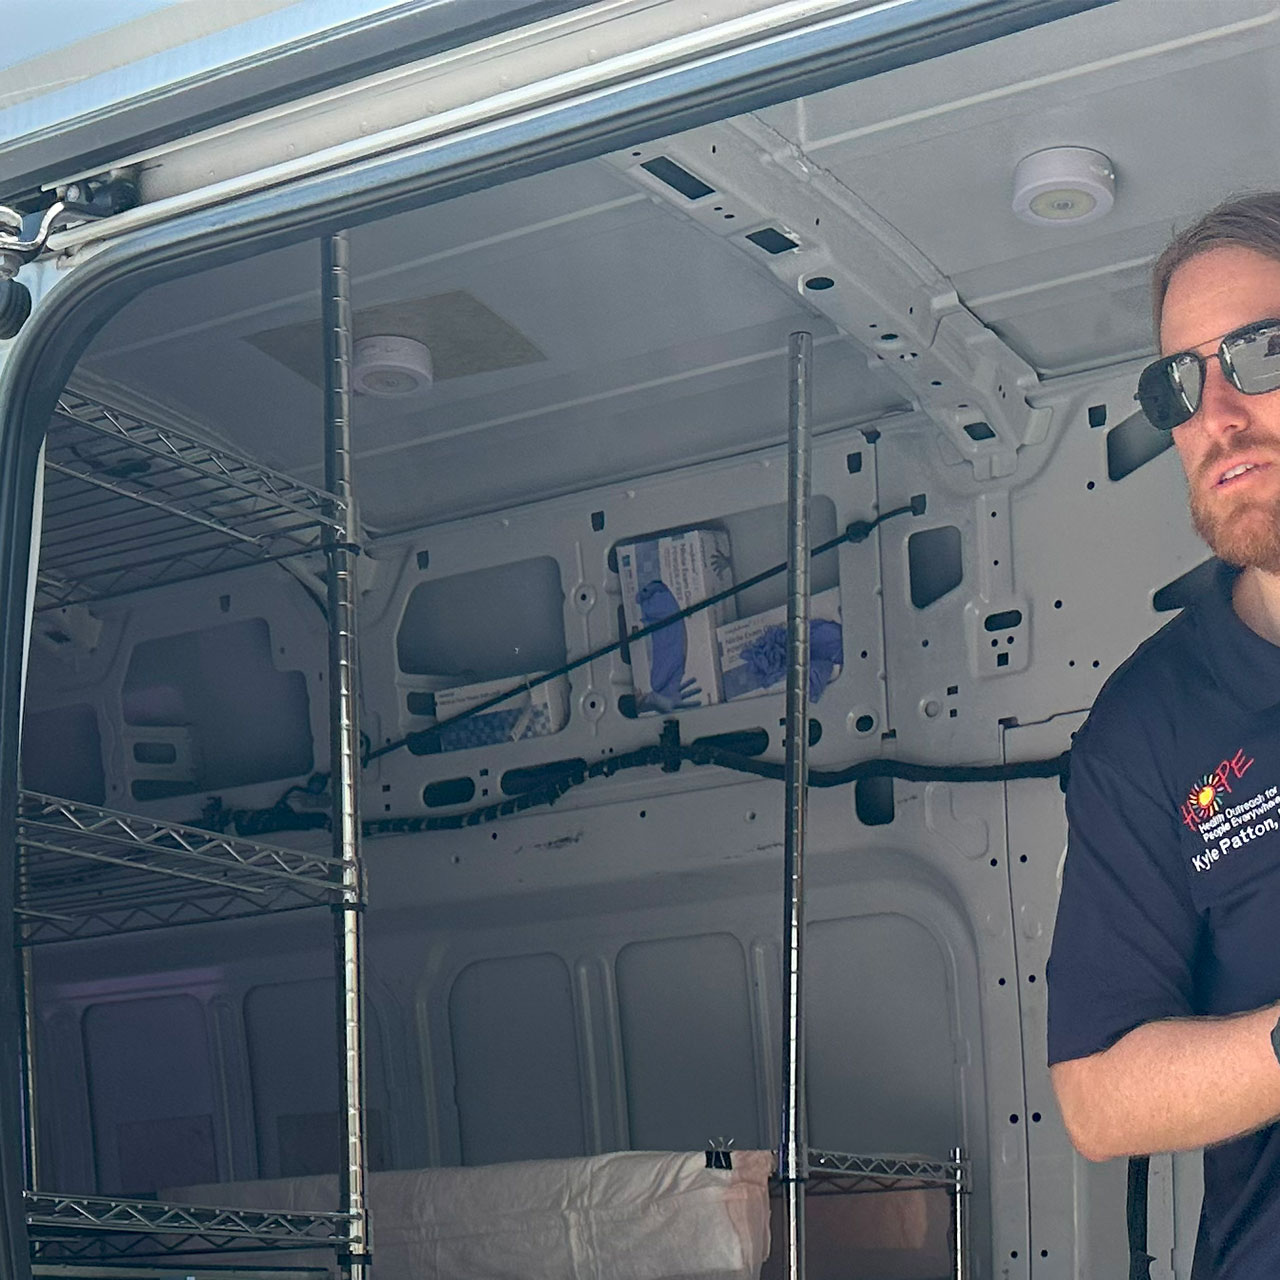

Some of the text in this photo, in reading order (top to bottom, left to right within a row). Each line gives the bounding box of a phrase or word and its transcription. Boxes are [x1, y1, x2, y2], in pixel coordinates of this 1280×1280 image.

[1180, 748, 1254, 832] HOPE
[1198, 785, 1279, 833] Health Outreach for
[1191, 846, 1221, 872] Kyle
[1219, 818, 1279, 855] Patton,
[1202, 822, 1231, 842] People
